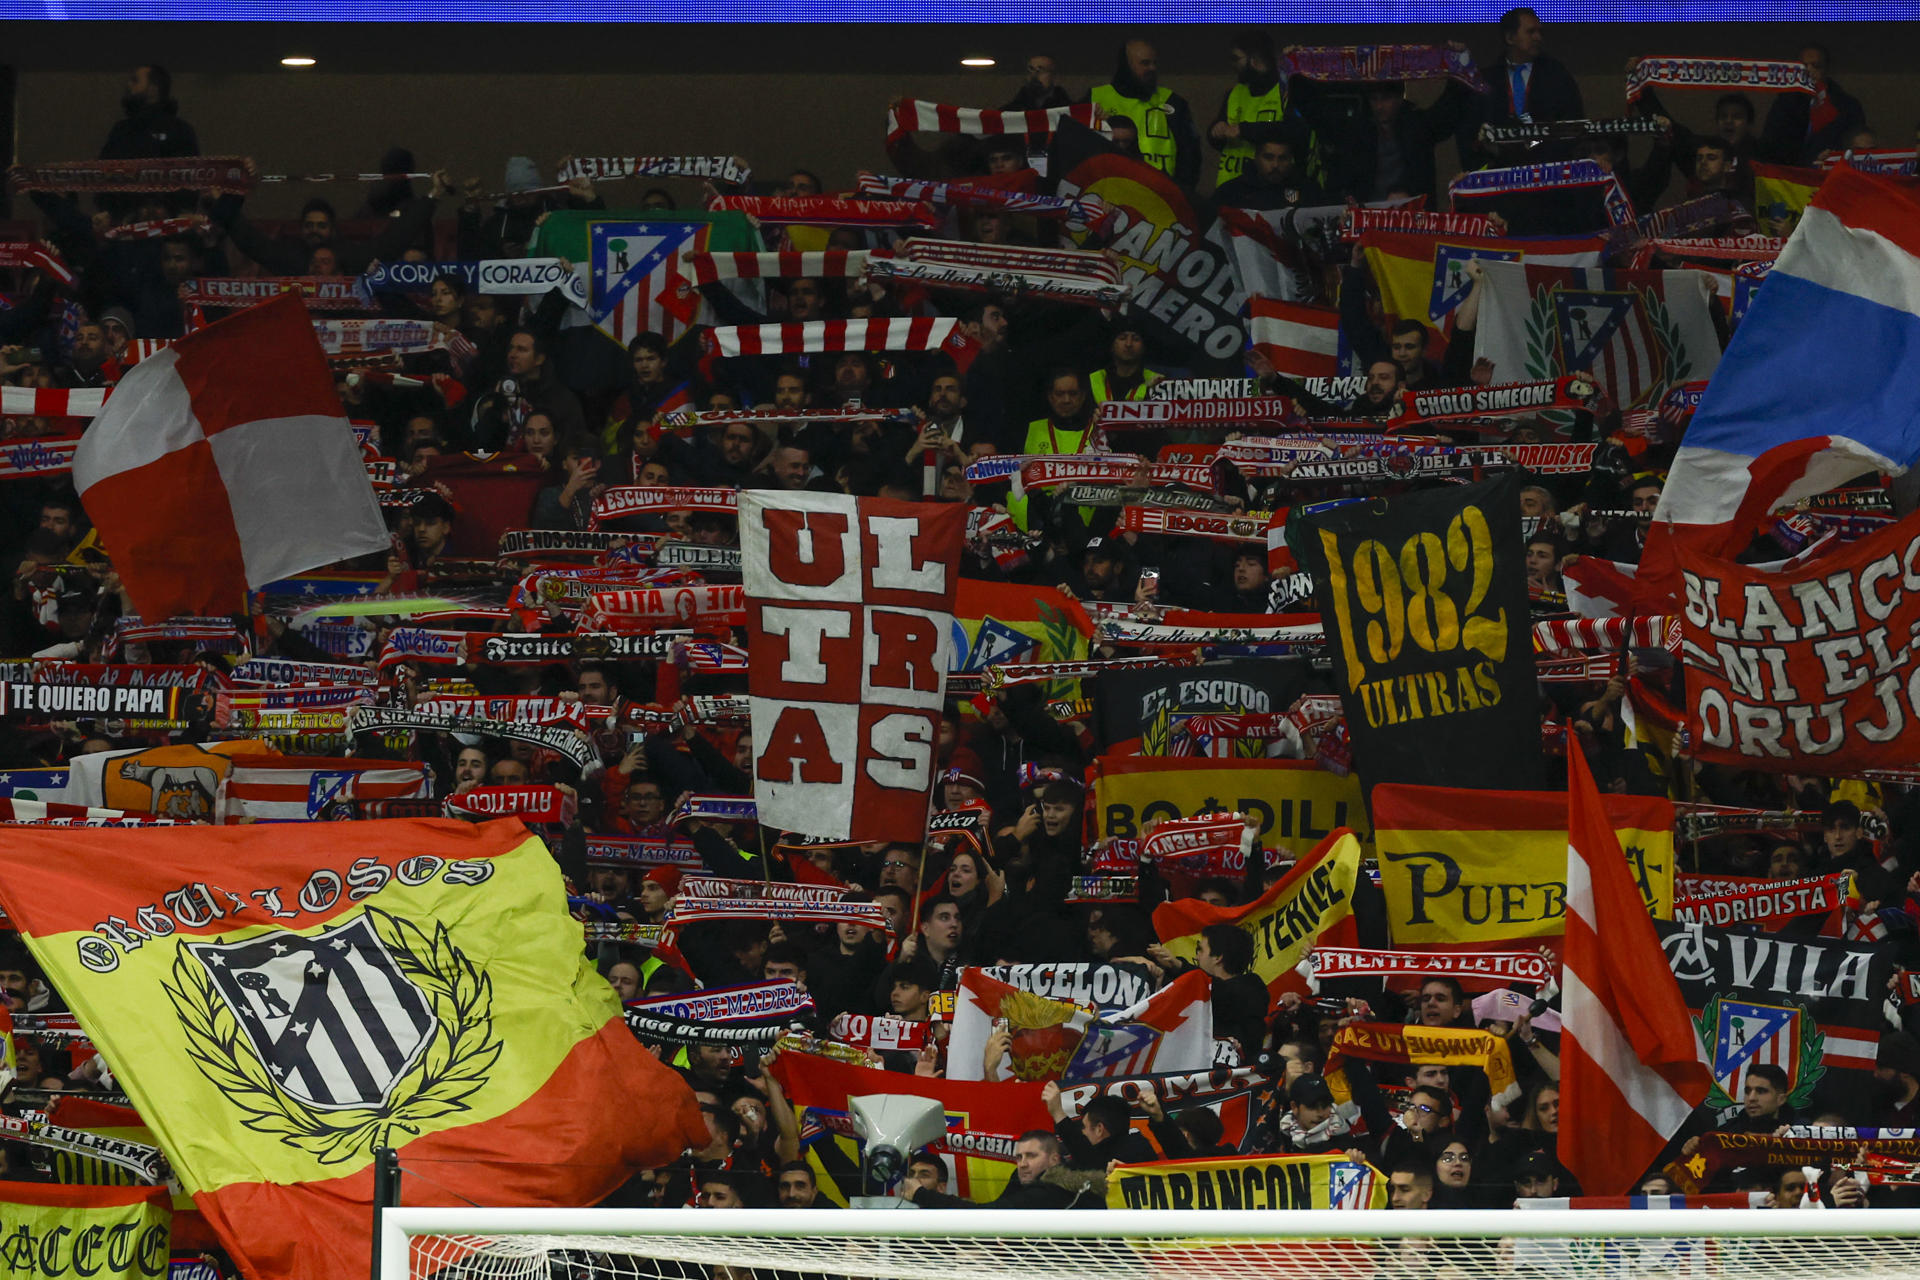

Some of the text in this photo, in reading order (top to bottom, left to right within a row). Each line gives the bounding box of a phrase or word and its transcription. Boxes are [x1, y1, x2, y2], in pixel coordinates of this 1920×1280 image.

[463, 263, 476, 284] Y
[206, 280, 281, 298] FRENTE
[1415, 383, 1554, 418] CHOLO SIMEONE
[1292, 453, 1455, 479] ANATICOS DEL
[607, 489, 665, 511] ESCUDO
[1317, 505, 1509, 695] 1982
[486, 636, 573, 662] Frente
[11, 684, 165, 714] TE QUIERO PAPA
[1178, 680, 1271, 715] ESCUDO
[1359, 660, 1502, 729] ULTRAS
[258, 711, 345, 729] ATLETICO
[1674, 886, 1828, 928] MADRIDISTA
[1323, 954, 1544, 977] FRENTE ATLETICO
[45, 1125, 153, 1164] FULHAM
[1716, 1132, 1785, 1151] ROMA
[1790, 1137, 1846, 1152] CLUB
